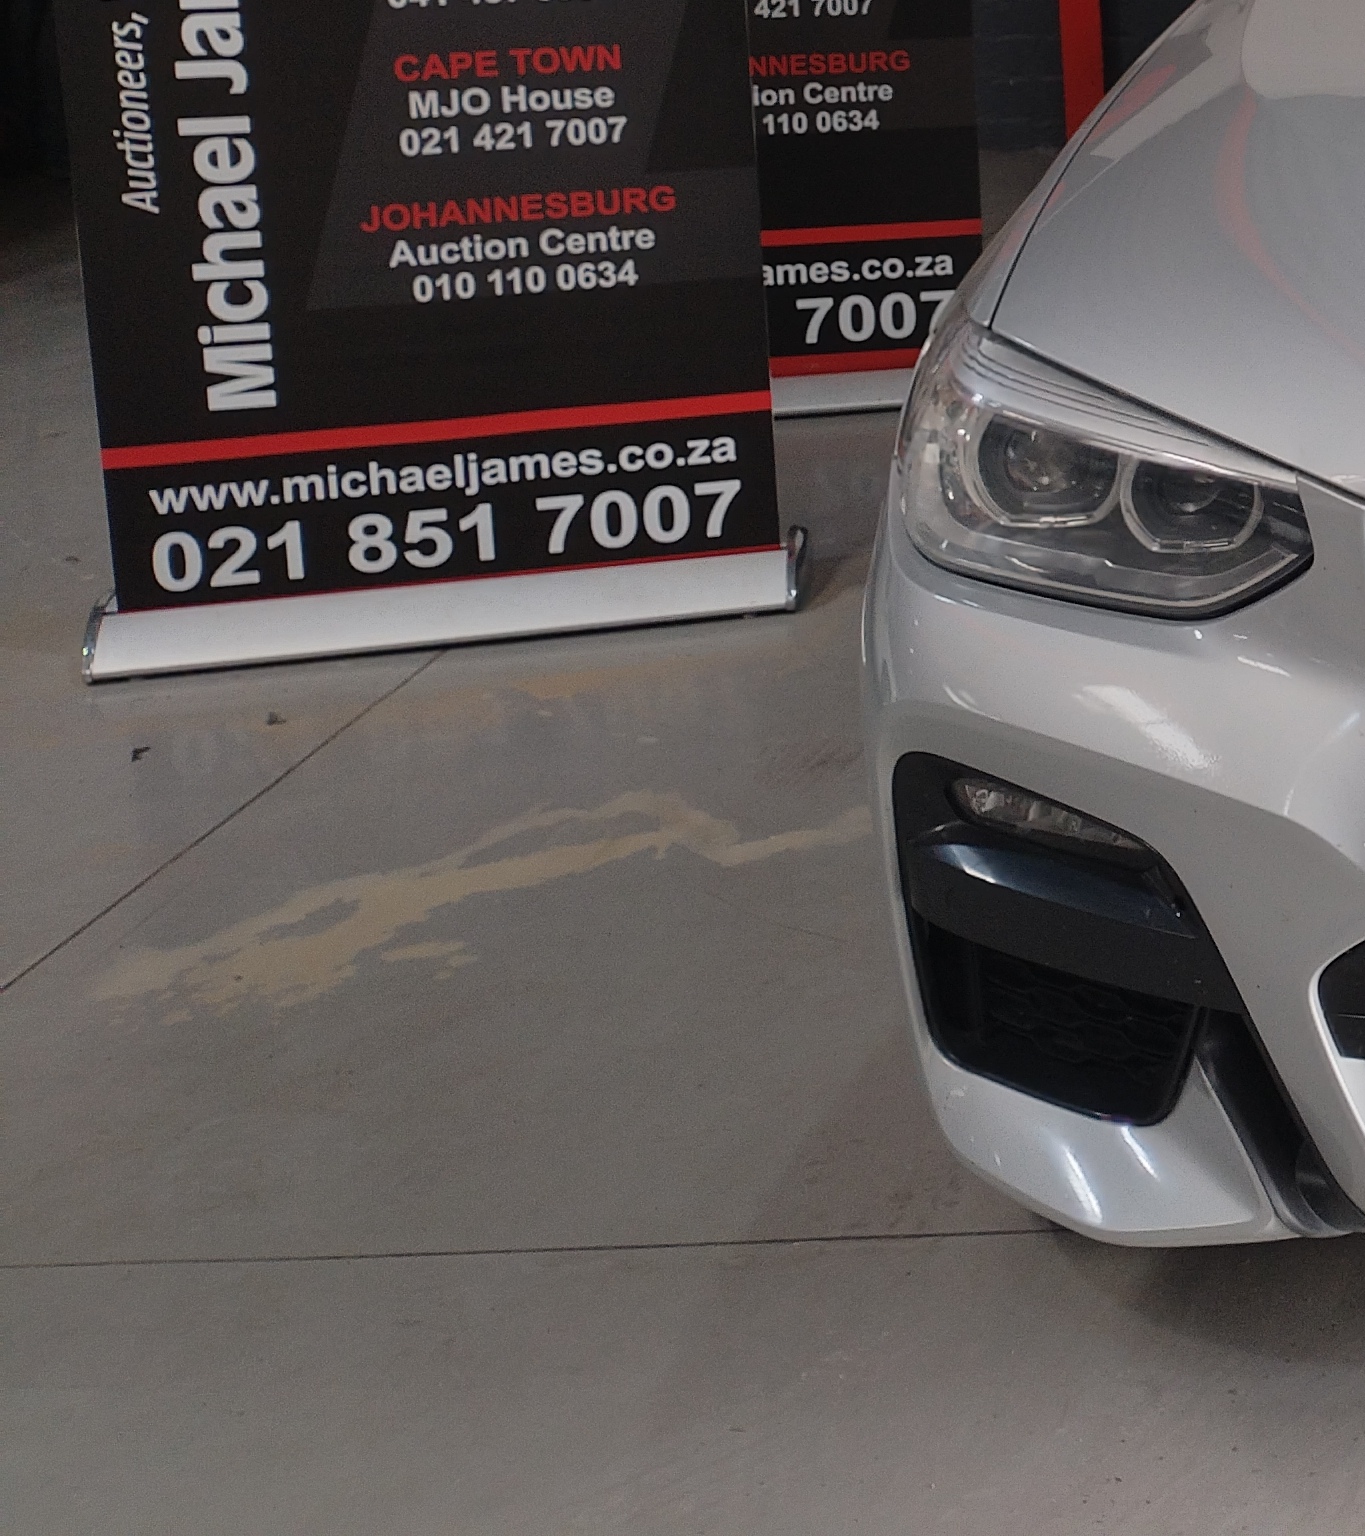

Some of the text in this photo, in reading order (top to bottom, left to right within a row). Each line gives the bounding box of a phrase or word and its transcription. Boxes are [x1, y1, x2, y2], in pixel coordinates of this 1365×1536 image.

[393, 44, 622, 82] CAPE TOWN
[748, 49, 911, 77] NNESBURG
[111, 12, 160, 215] Auctioneers,
[408, 84, 615, 119] MJO House
[803, 81, 894, 105] Centre
[399, 115, 628, 157] 021 421 7007
[762, 108, 880, 136] 110 0634
[360, 185, 677, 233] JOHANNESBURG
[177, 115, 277, 412] Michael
[389, 225, 656, 269] Auction Centre
[412, 258, 639, 303] 010 110 0634
[148, 436, 739, 516] www.michaeljames.co.za
[152, 478, 742, 592] 021 851 7007
